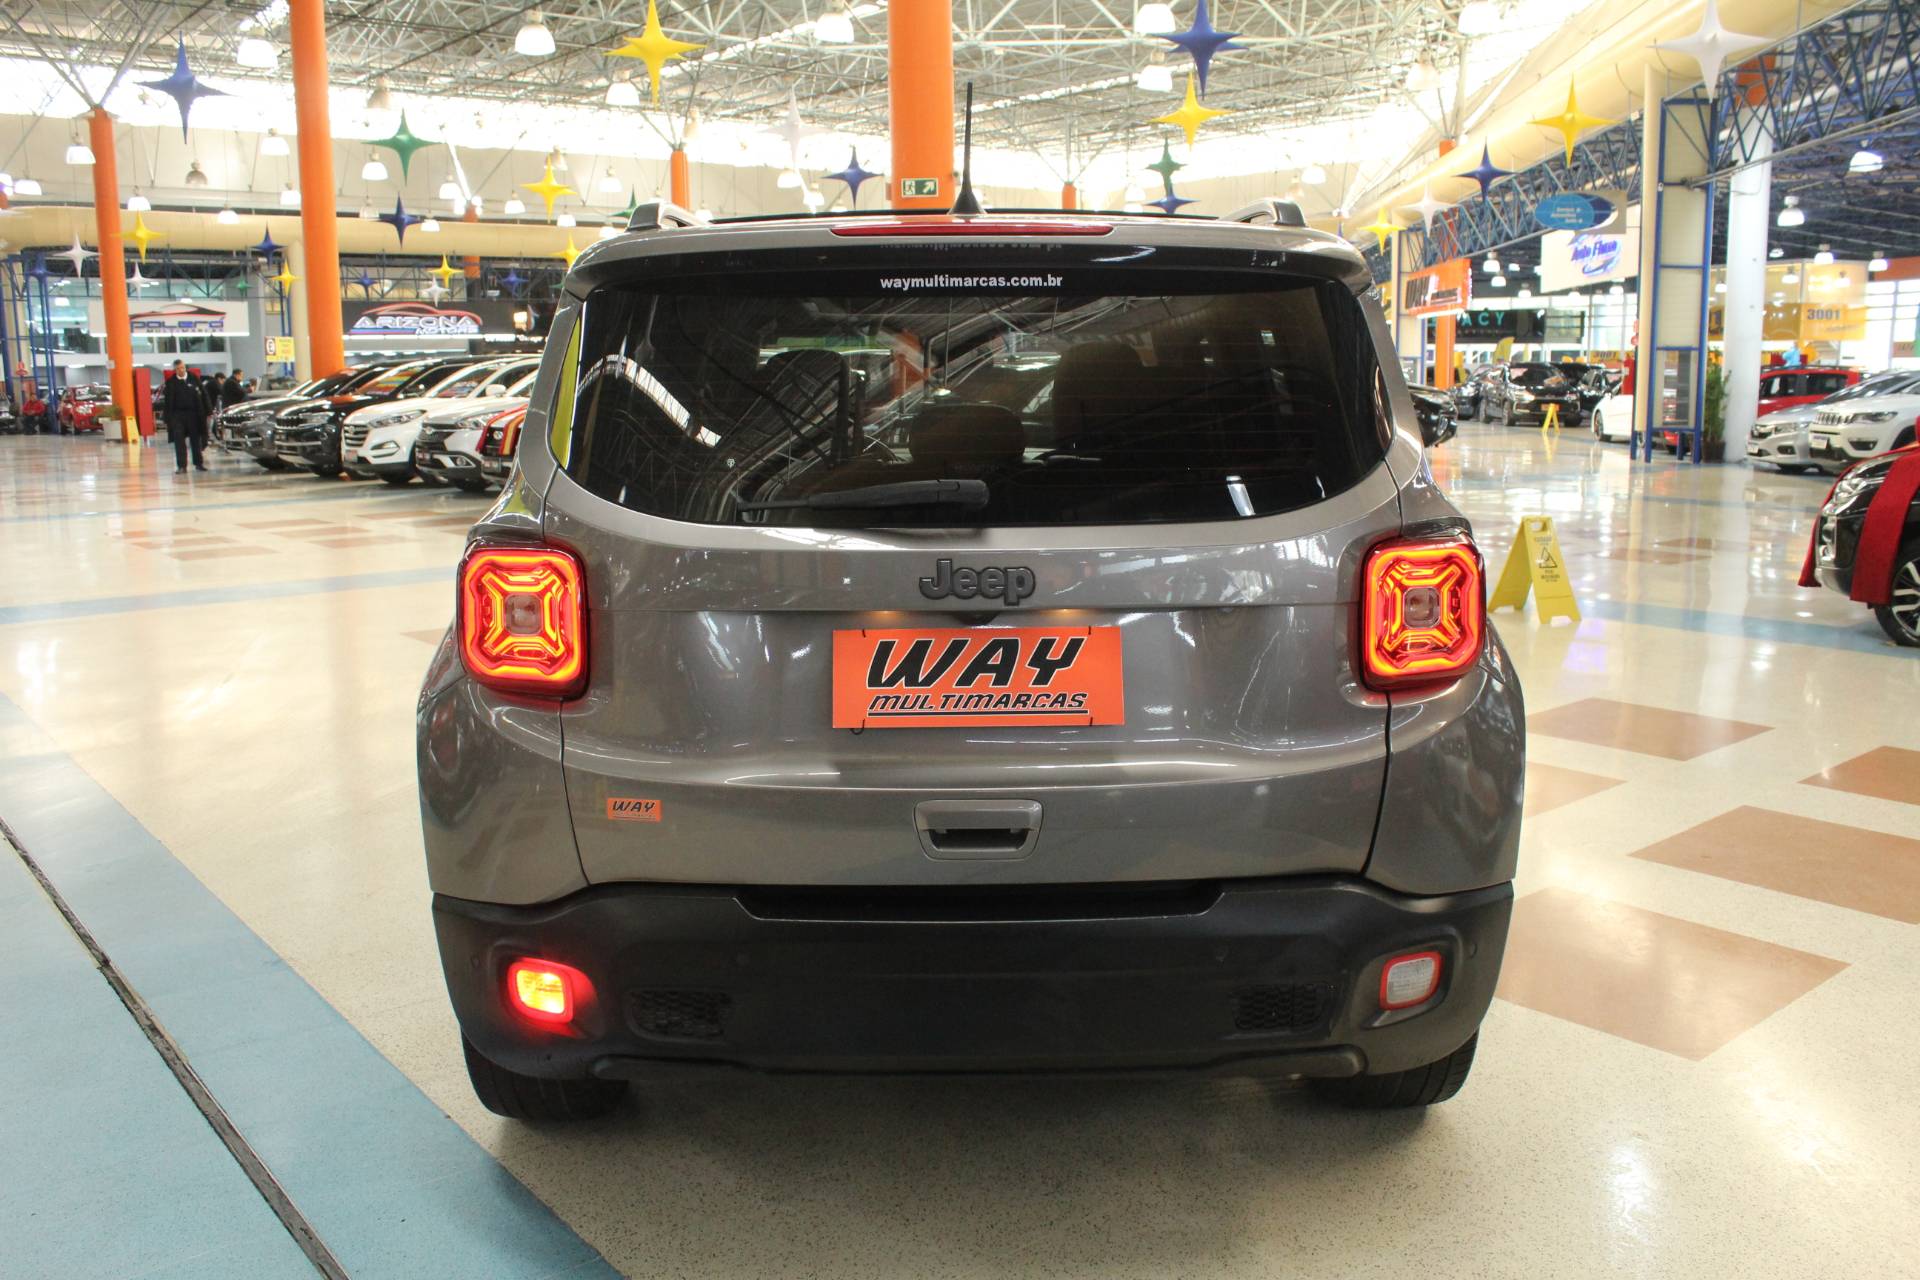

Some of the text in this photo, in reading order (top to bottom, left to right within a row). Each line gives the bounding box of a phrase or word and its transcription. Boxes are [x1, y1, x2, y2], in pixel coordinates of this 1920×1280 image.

[880, 274, 1063, 291] waymultimarcas.com.br
[353, 315, 479, 328] ARIZONA
[1807, 308, 1840, 320] 3001
[919, 558, 1036, 606] Jeep
[866, 636, 1088, 689] WAY
[868, 692, 1088, 711] MULTIMARCAS
[612, 800, 655, 813] WAY
